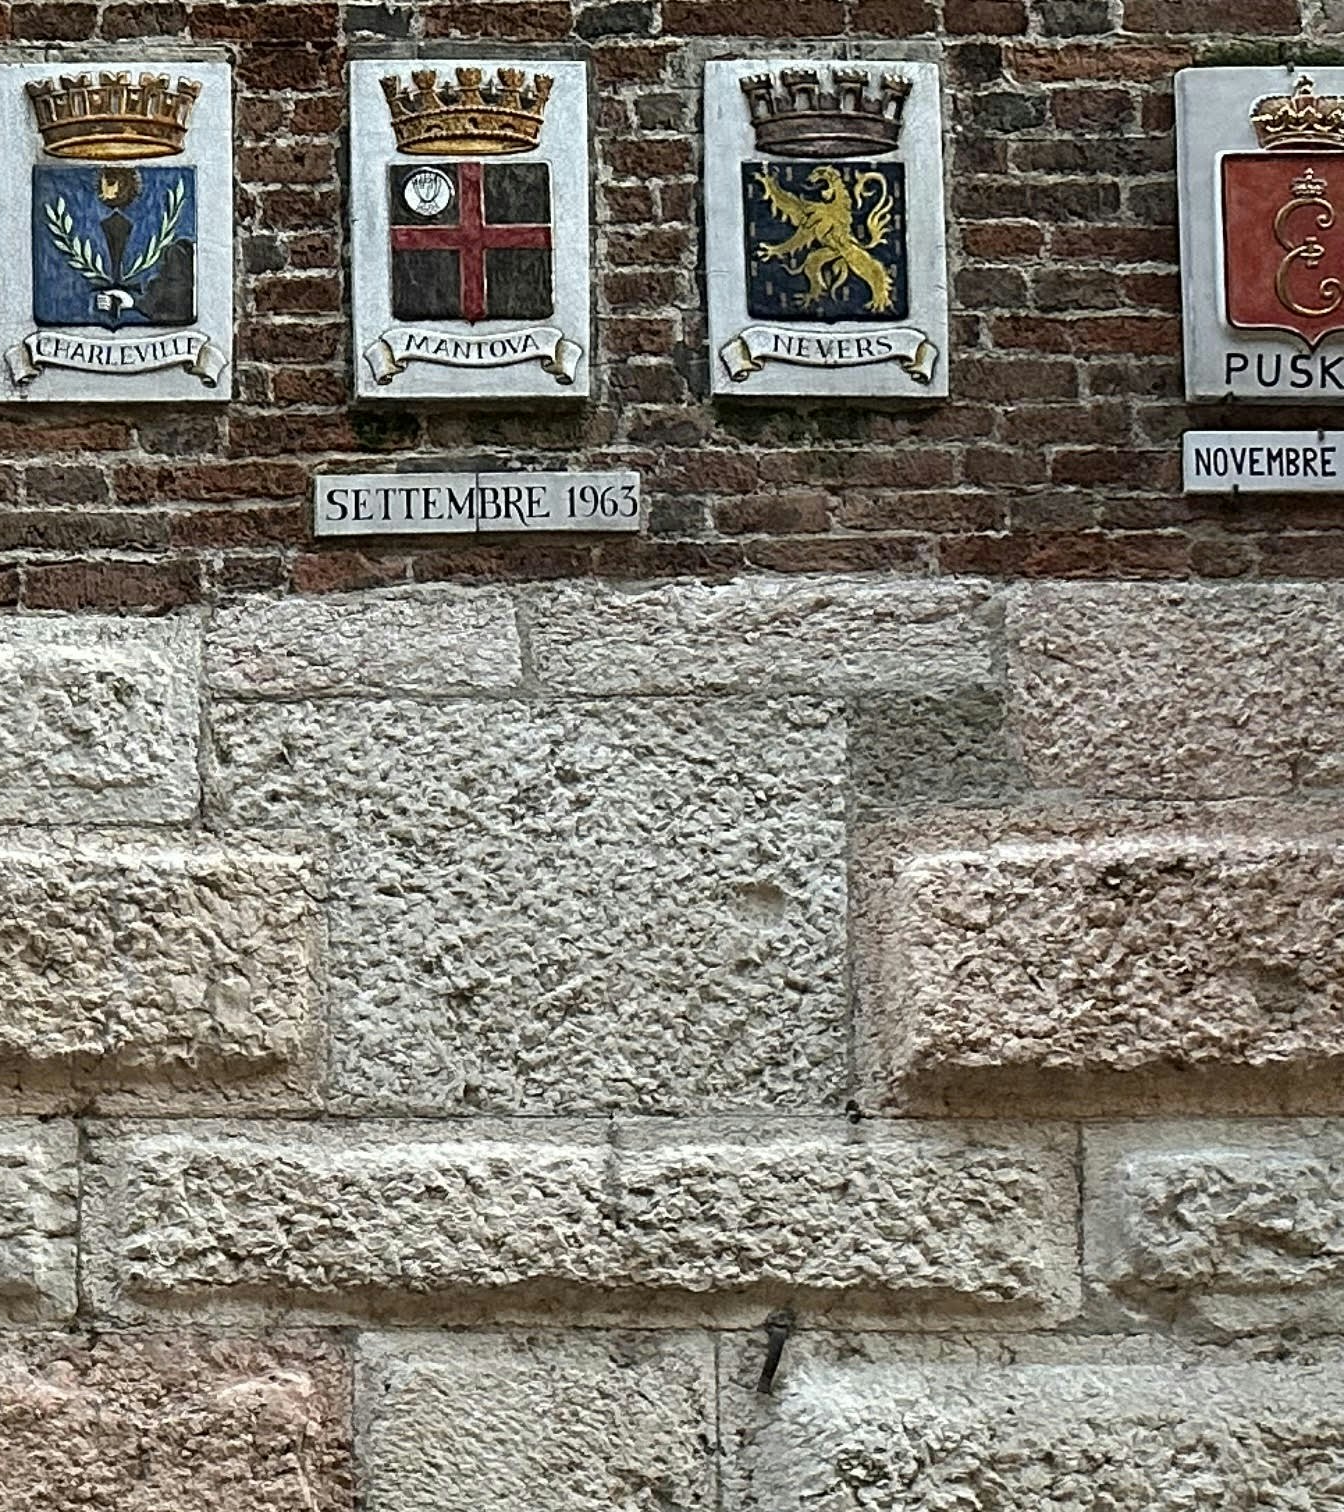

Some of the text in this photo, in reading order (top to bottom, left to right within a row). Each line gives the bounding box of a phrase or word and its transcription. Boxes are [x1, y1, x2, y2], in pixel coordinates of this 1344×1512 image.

[35, 335, 199, 366] CHARLEVILLE
[405, 333, 540, 361] MANTOVA
[772, 333, 894, 360] NEVERS
[1225, 352, 1344, 390] PUSK
[1194, 446, 1337, 478] NOVEMBRE
[324, 484, 639, 526] SETTEMBRE 1963
